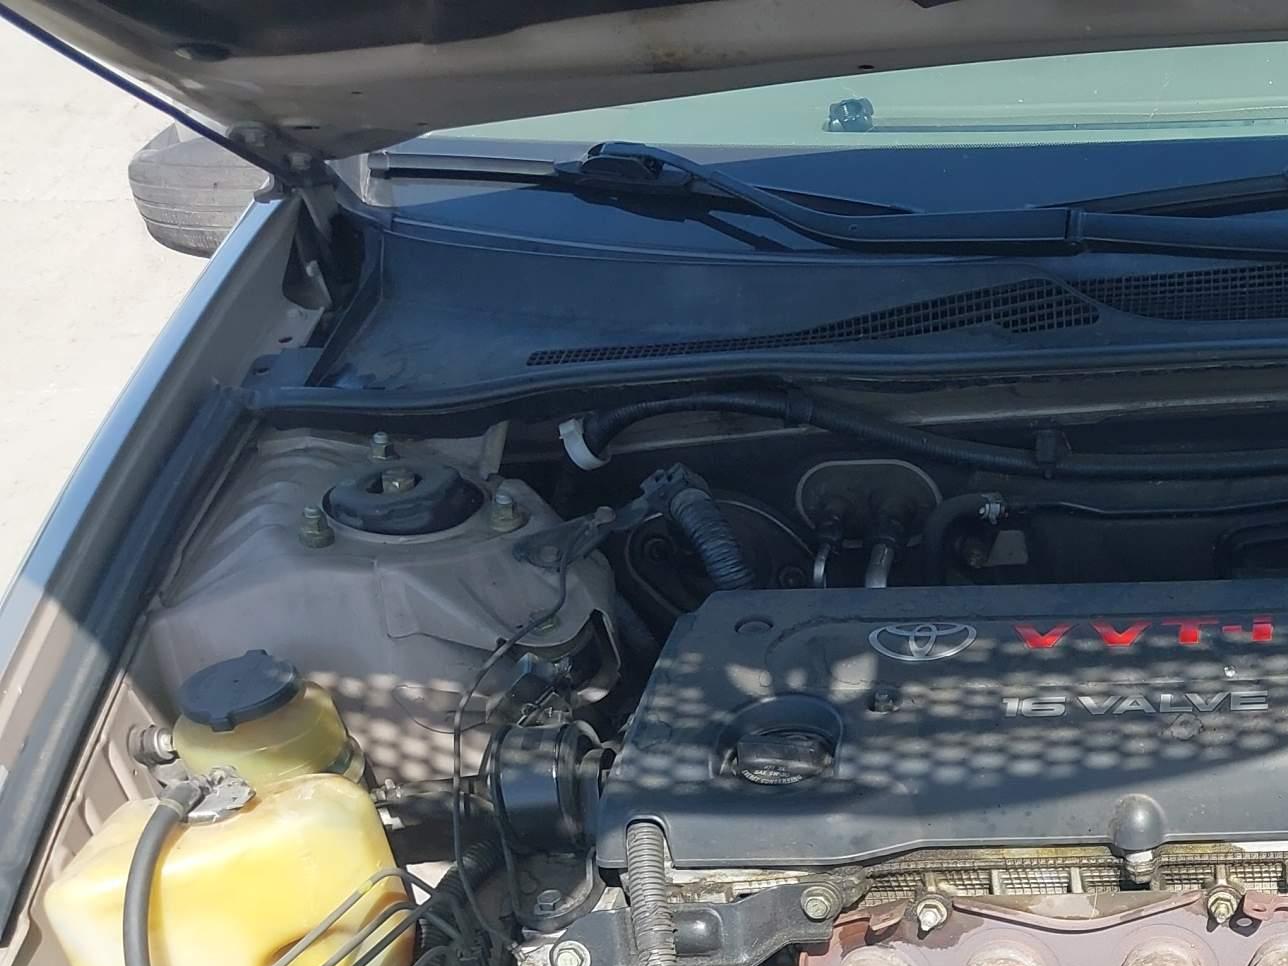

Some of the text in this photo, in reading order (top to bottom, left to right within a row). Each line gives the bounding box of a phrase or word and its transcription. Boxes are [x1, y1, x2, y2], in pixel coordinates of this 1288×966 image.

[1013, 616, 1274, 649] VVT-i
[1002, 690, 1269, 718] 16 VALVE
